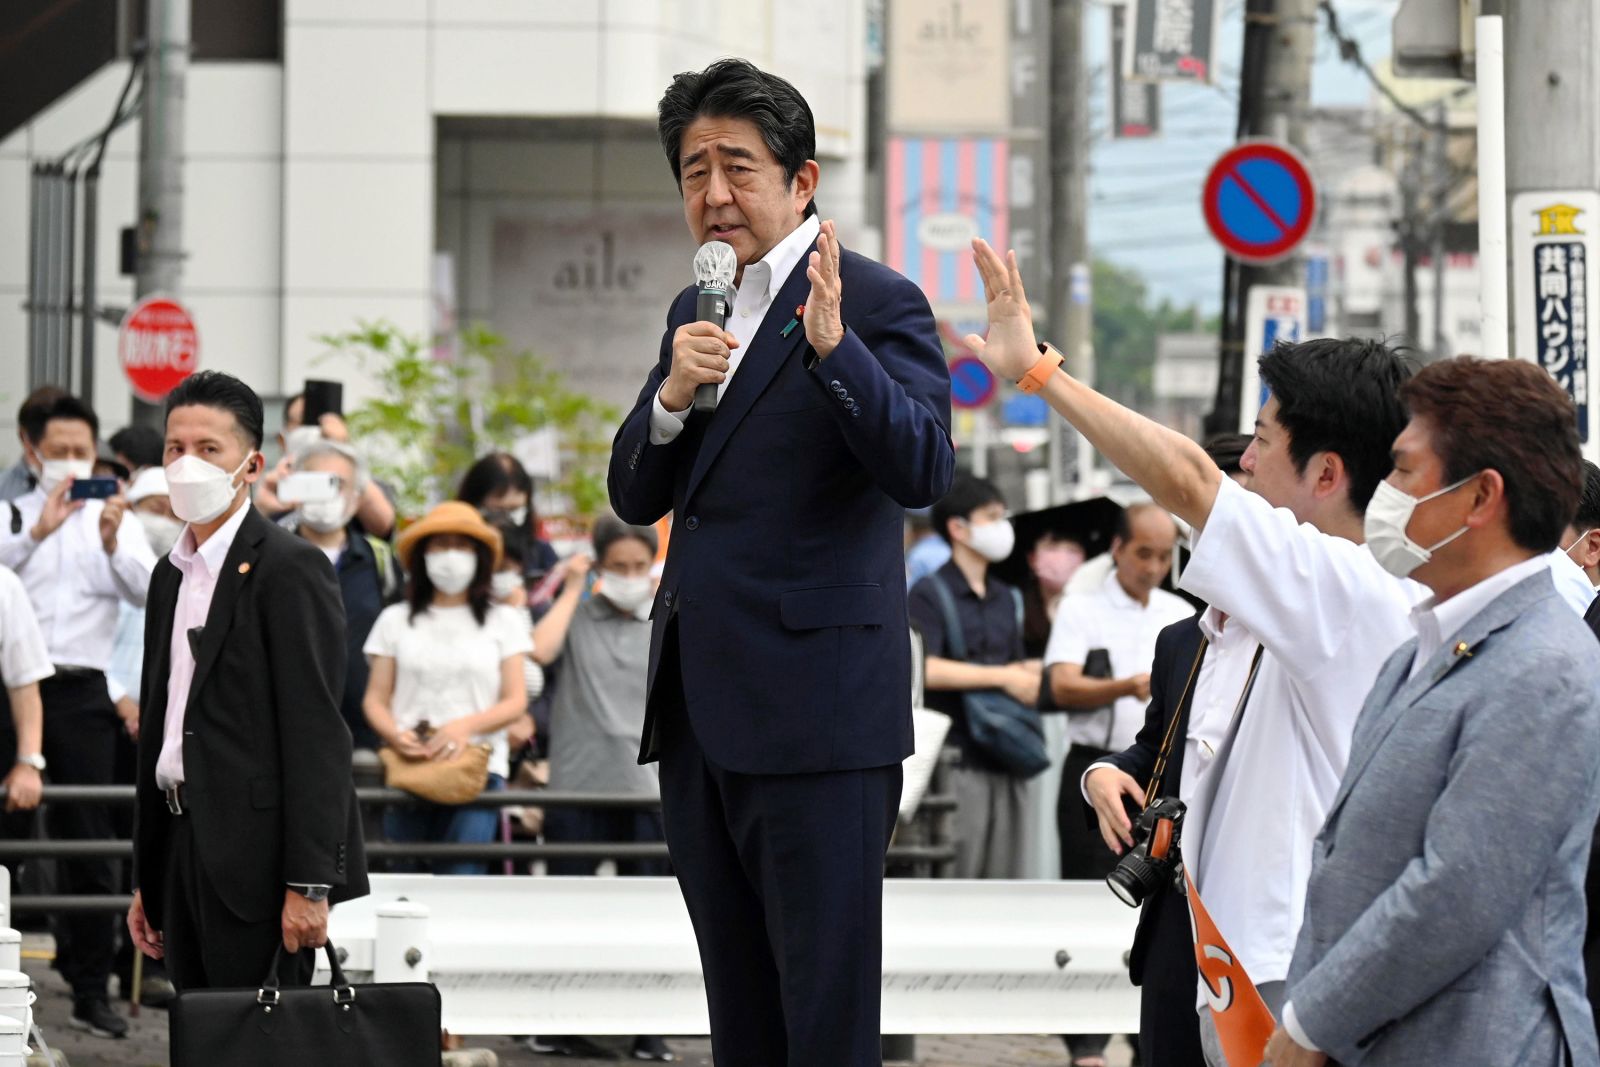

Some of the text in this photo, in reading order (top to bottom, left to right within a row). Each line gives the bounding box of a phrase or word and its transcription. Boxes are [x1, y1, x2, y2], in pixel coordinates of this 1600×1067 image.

[553, 230, 645, 290] aile
[1539, 246, 1572, 394] 共同ハウジン
